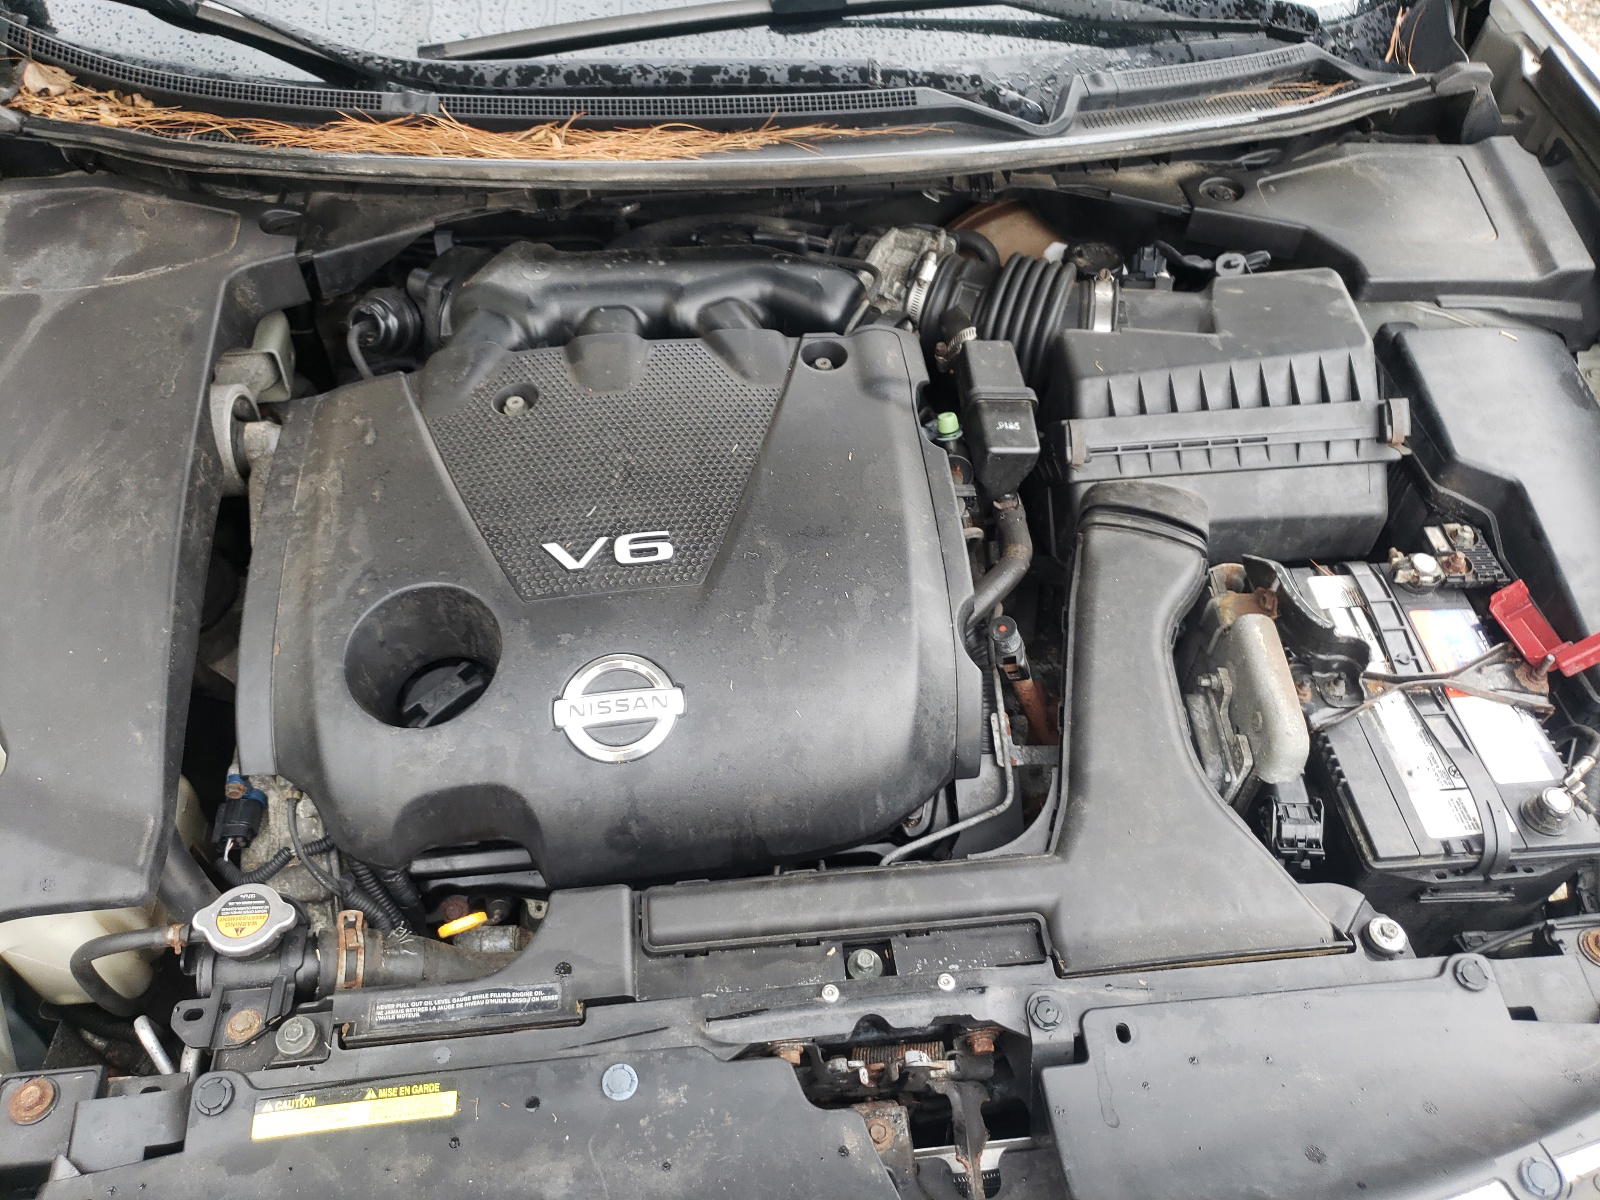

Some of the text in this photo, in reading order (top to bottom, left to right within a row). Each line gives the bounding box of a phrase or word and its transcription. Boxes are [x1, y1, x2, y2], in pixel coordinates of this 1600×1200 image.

[541, 530, 674, 570] V6
[569, 695, 669, 718] NISSAN
[451, 995, 472, 1003] GAUGE
[472, 993, 489, 1001] WHILE
[490, 991, 511, 999] FILLING
[511, 990, 533, 998] ENGINE
[437, 1003, 455, 1011] JAUGE
[464, 999, 485, 1008] NIVEAU
[378, 1082, 441, 1098] MISE EN GARDE
[274, 1096, 317, 1112] CAUTION
